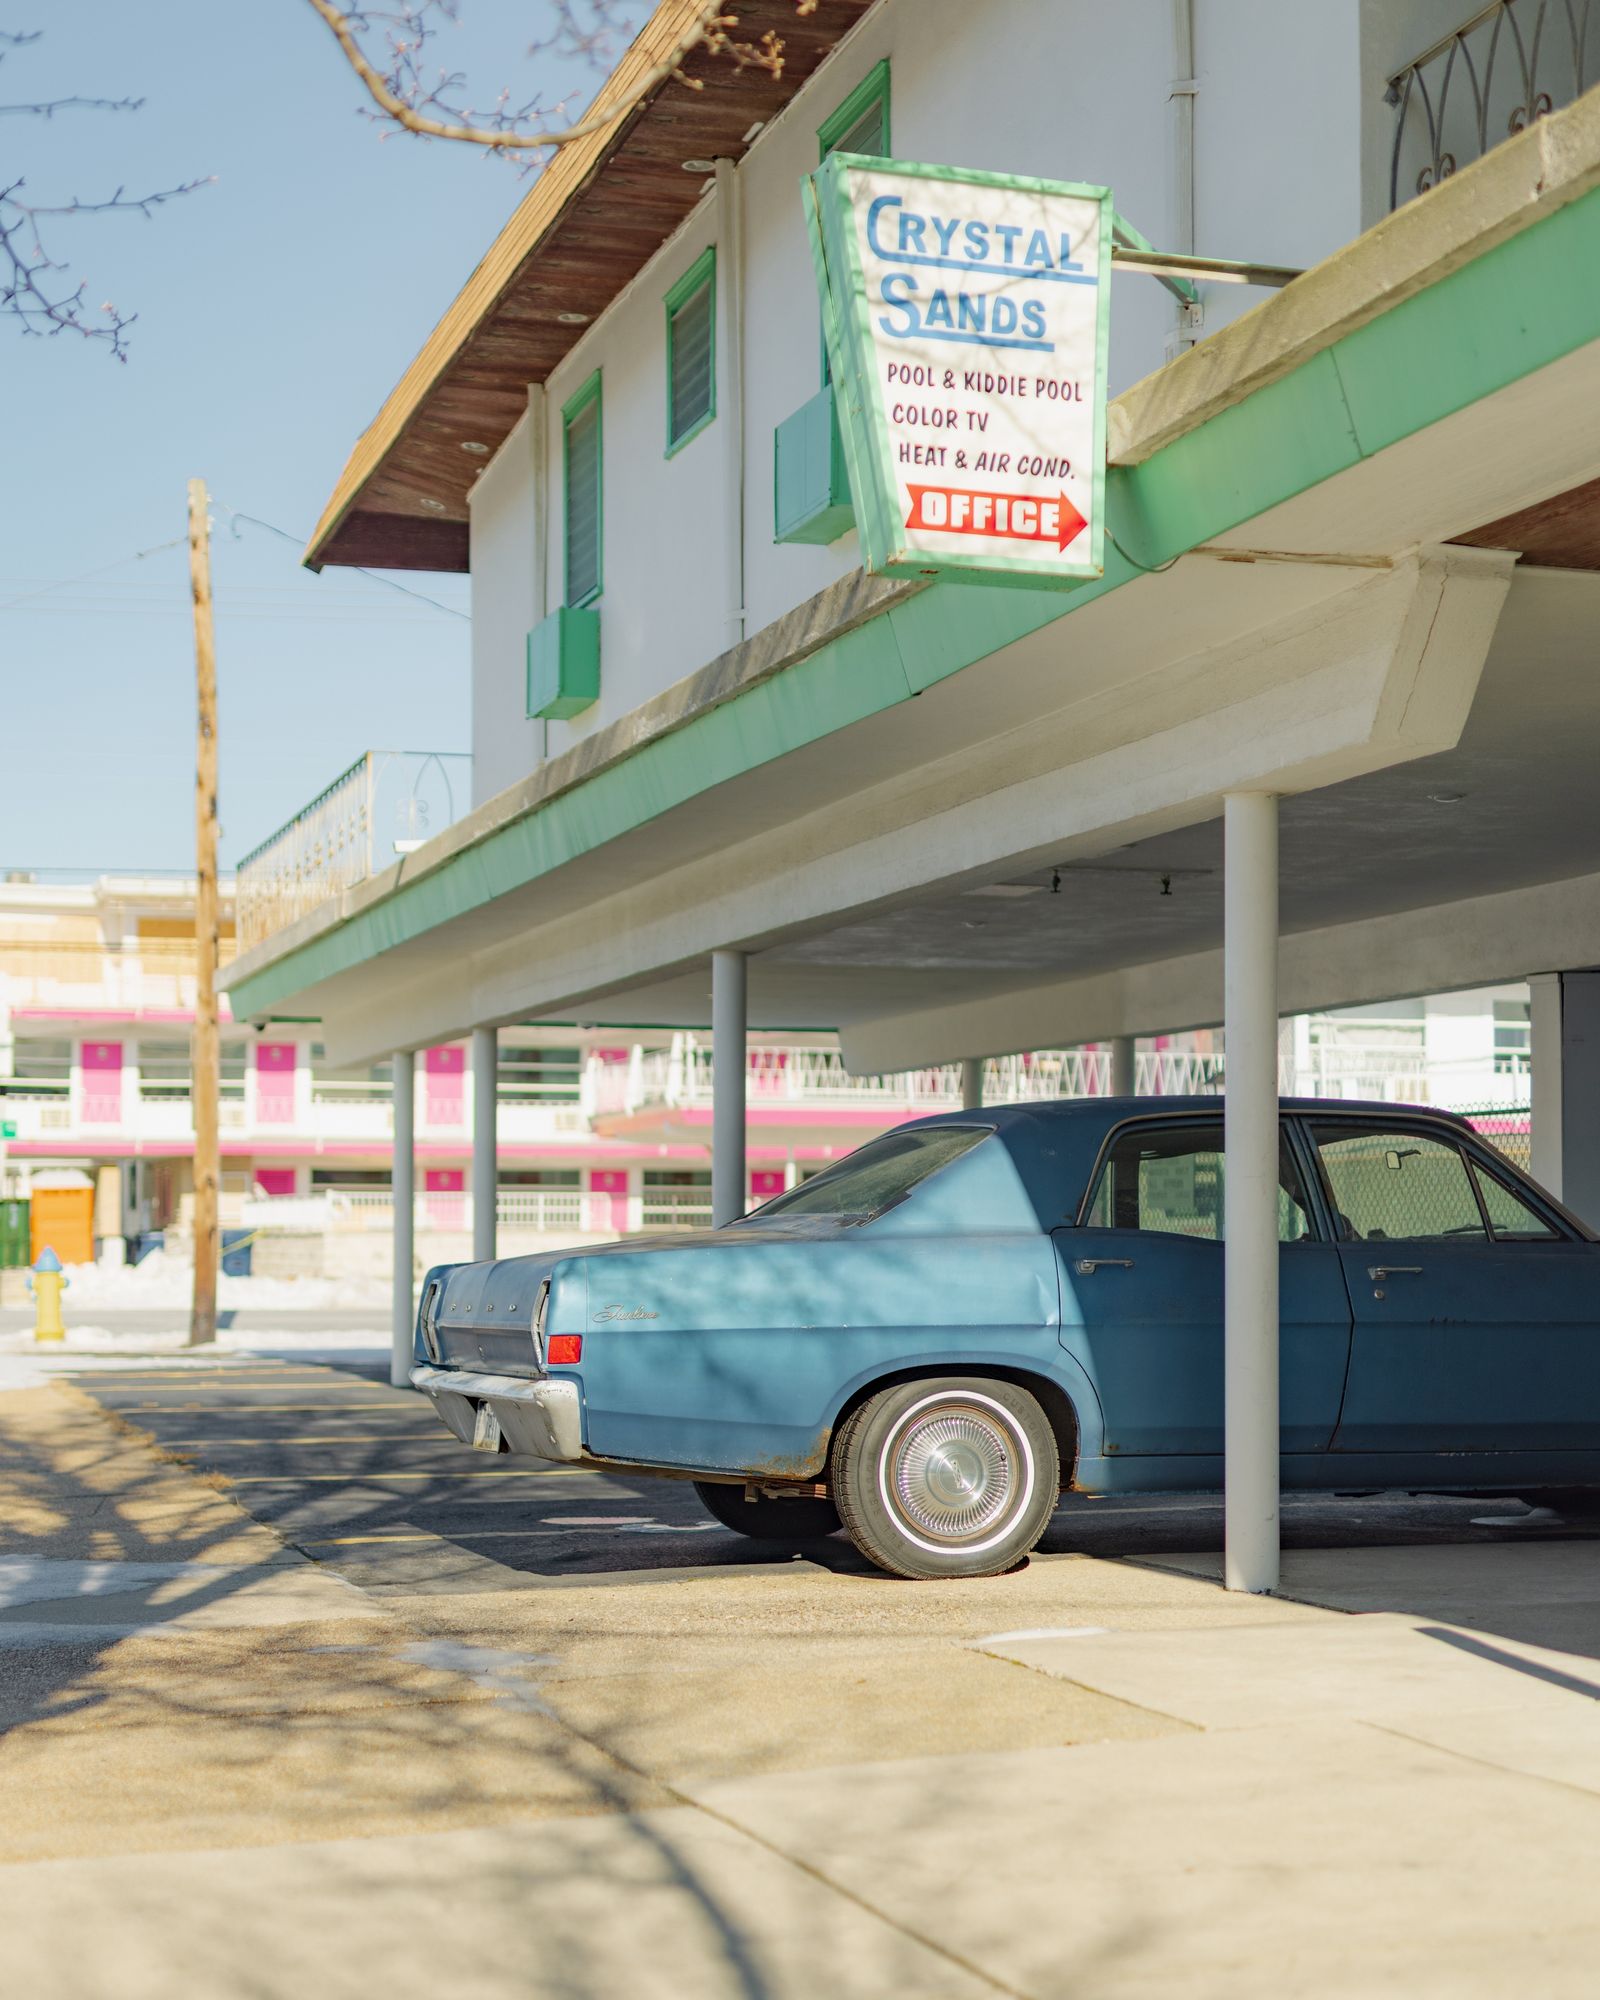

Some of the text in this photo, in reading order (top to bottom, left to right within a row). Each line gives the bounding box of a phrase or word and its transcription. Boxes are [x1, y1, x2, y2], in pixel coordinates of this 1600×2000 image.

[866, 195, 1085, 273] CRYSTAL
[878, 272, 1048, 340] SANDS
[887, 362, 1083, 402] POOL & KIDDIE POOL
[892, 403, 989, 432] COLOR TV
[899, 442, 1076, 480] HEAT & AIR COND.
[920, 490, 1060, 537] OFFICE
